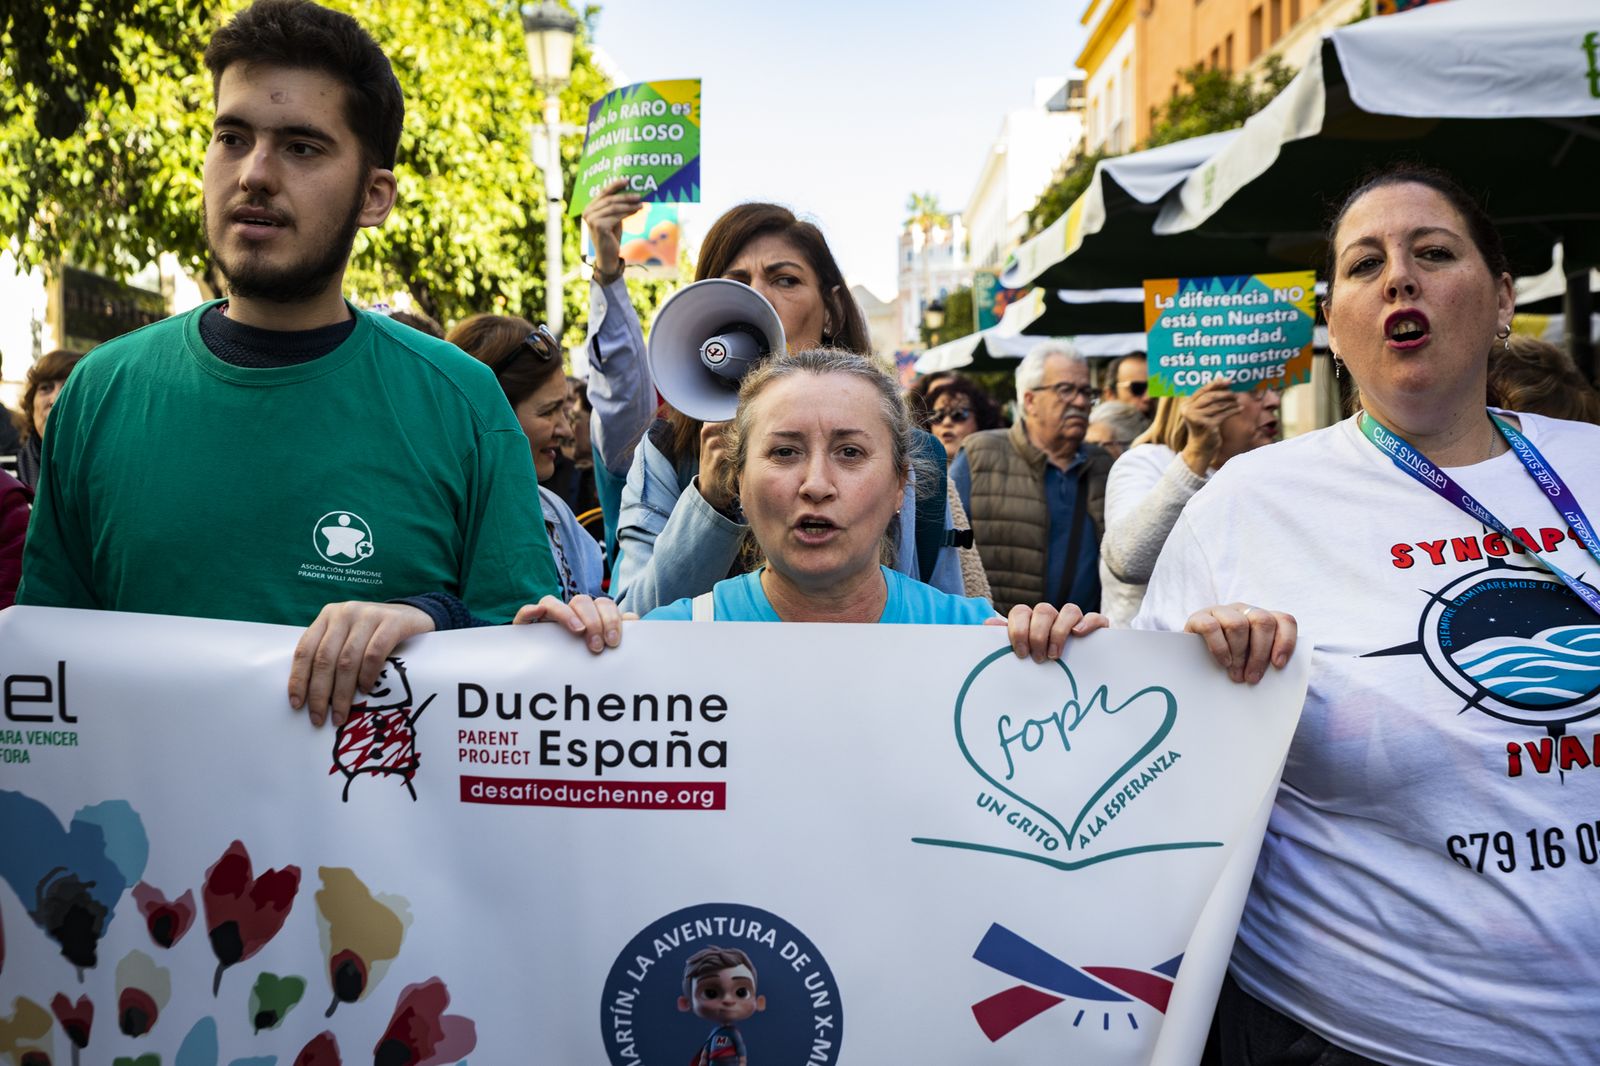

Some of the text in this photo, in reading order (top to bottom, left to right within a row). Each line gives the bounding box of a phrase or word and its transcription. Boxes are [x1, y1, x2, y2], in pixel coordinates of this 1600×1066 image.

[620, 99, 667, 119] RARO
[671, 102, 692, 115] es
[586, 123, 684, 157] MARAVILLOSO
[613, 152, 683, 174] persona
[1155, 286, 1304, 309] La diferencia NO
[1161, 309, 1299, 328] está en Nuestra
[1172, 327, 1286, 347] Enfermedad,
[1159, 347, 1301, 367] está en nuestros
[1373, 426, 1448, 489] CURE SYNGAP1
[1534, 469, 1560, 497] CURE
[1461, 495, 1491, 520] CURE
[297, 570, 383, 585] PRADER WILLI ANDALUZA
[300, 563, 382, 578] ASOCIACIÓN SÍNDROME
[1562, 574, 1595, 601] CURE
[1439, 606, 1457, 647] SIEMPRE
[1453, 580, 1537, 607] CAMINAREMOS
[1542, 582, 1557, 592] DE
[0, 660, 78, 723] el
[457, 682, 728, 722] Duchenne
[26, 730, 78, 747] VENCER
[458, 729, 518, 746] PARENT
[997, 699, 1082, 781] fop
[458, 748, 531, 766] PROJECT
[539, 729, 728, 777] España
[1507, 733, 1600, 778] ¡VA
[470, 781, 715, 808] desafioduchenne.org
[975, 750, 1182, 852] UN GRITO A LA ESPERANZA
[1446, 830, 1517, 874] 679
[1526, 826, 1566, 872] 16
[610, 985, 641, 1066] ARTÍN,
[626, 954, 655, 983] LA
[652, 916, 777, 958] AVENTURA
[779, 940, 812, 972] DE
[803, 971, 831, 1009] UN
